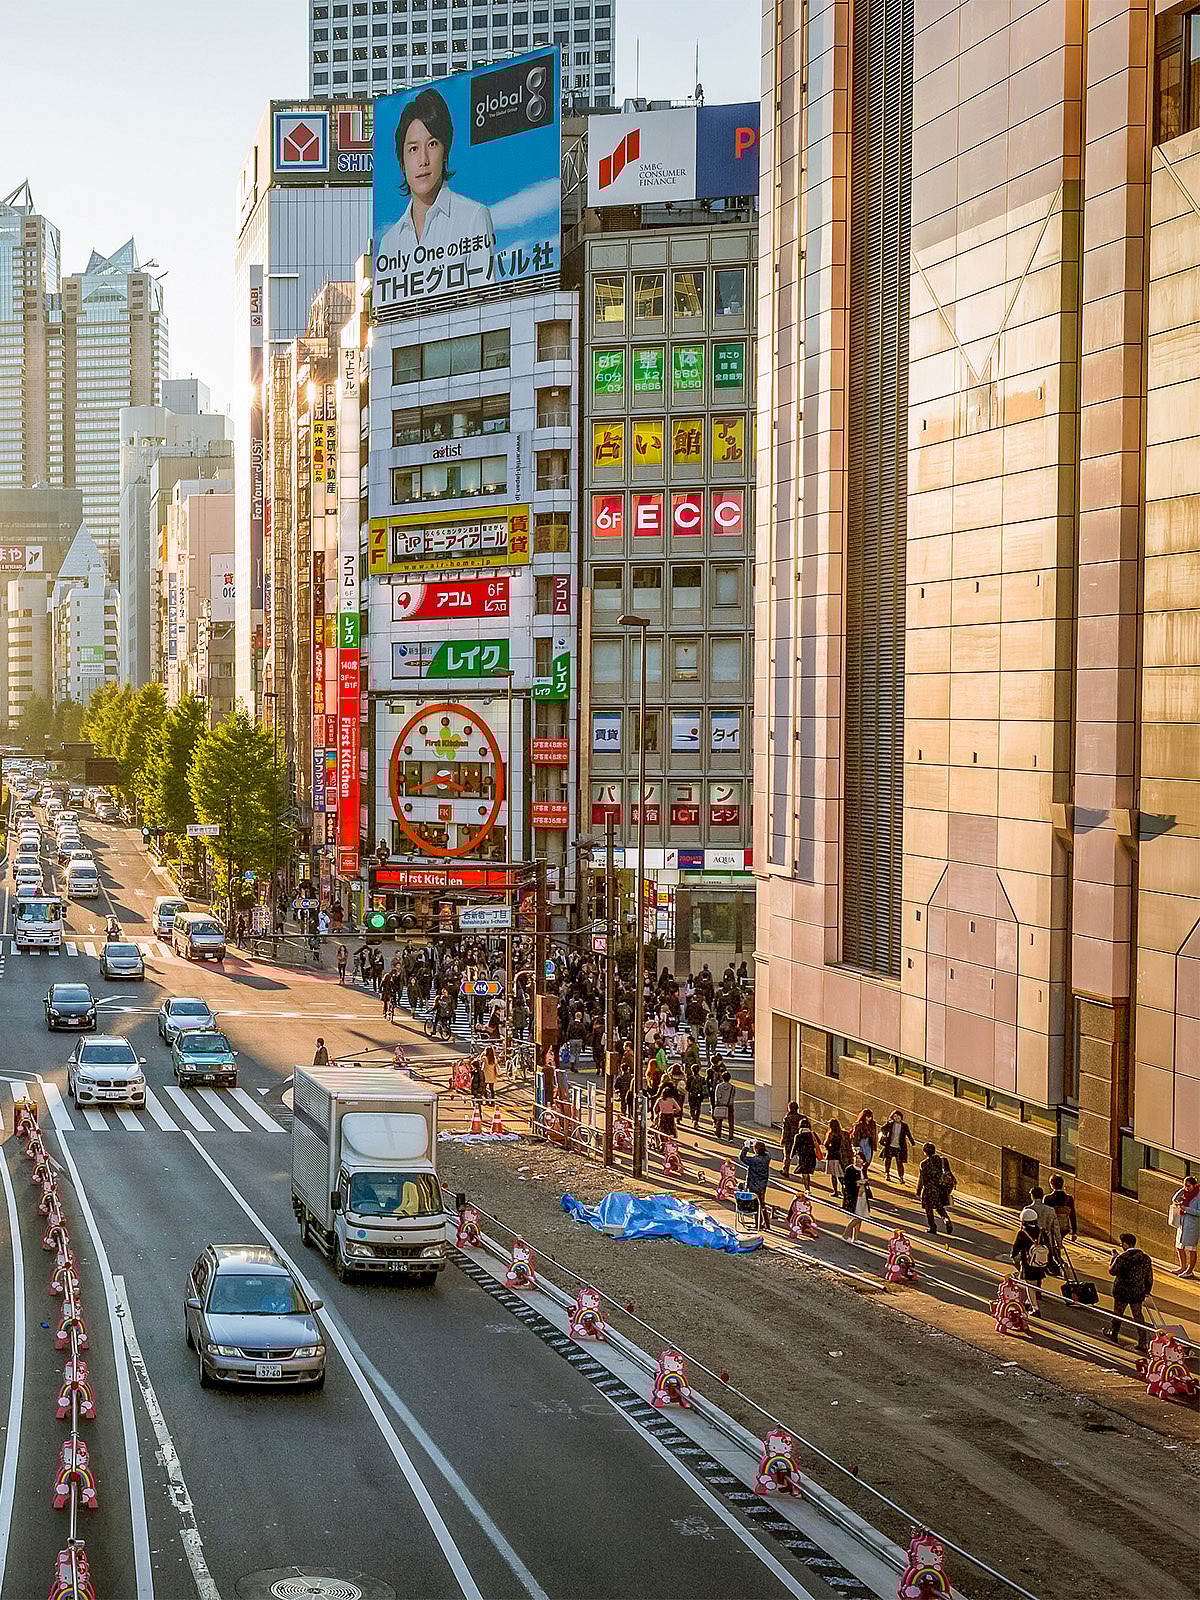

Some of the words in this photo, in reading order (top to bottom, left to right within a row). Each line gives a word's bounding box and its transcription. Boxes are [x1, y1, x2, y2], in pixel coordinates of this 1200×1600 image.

[476, 85, 522, 127] global
[639, 163, 663, 172] SMBC
[639, 169, 687, 179] CONSUMER
[639, 177, 677, 187] FINANCE
[376, 252, 410, 272] Only
[414, 245, 445, 265] One
[447, 232, 497, 257] の住まい
[377, 241, 555, 302] THEグローバル社
[250, 288, 259, 313] LABI
[344, 350, 356, 390] 村上ビル
[313, 423, 324, 448] 麻雀
[594, 427, 702, 460] 占い館
[253, 501, 263, 520] For
[596, 506, 621, 529] 6F
[637, 500, 741, 529] ECC
[425, 531, 508, 552] エーアイアール
[510, 515, 528, 554] 賃貸
[344, 555, 355, 587] アコム
[404, 559, 491, 571] www.air-home.jp
[436, 591, 472, 608] アコム
[488, 583, 504, 597] 6F
[556, 578, 567, 612] アコム
[495, 603, 507, 612] 入口
[345, 618, 355, 644] レイク
[340, 661, 358, 670] 140席
[447, 646, 501, 671] レイク
[557, 661, 567, 692] レイク
[535, 688, 551, 696] レイク
[341, 717, 351, 747] First
[425, 739, 440, 747] First
[442, 739, 469, 748] Kitchen
[595, 728, 619, 741] 賃貸
[315, 757, 324, 793] ソフマップ
[341, 749, 351, 798] Kitchen
[440, 808, 449, 817] FK
[672, 809, 698, 821] ICT
[713, 856, 736, 864] AQUA
[475, 984, 487, 992] 414
